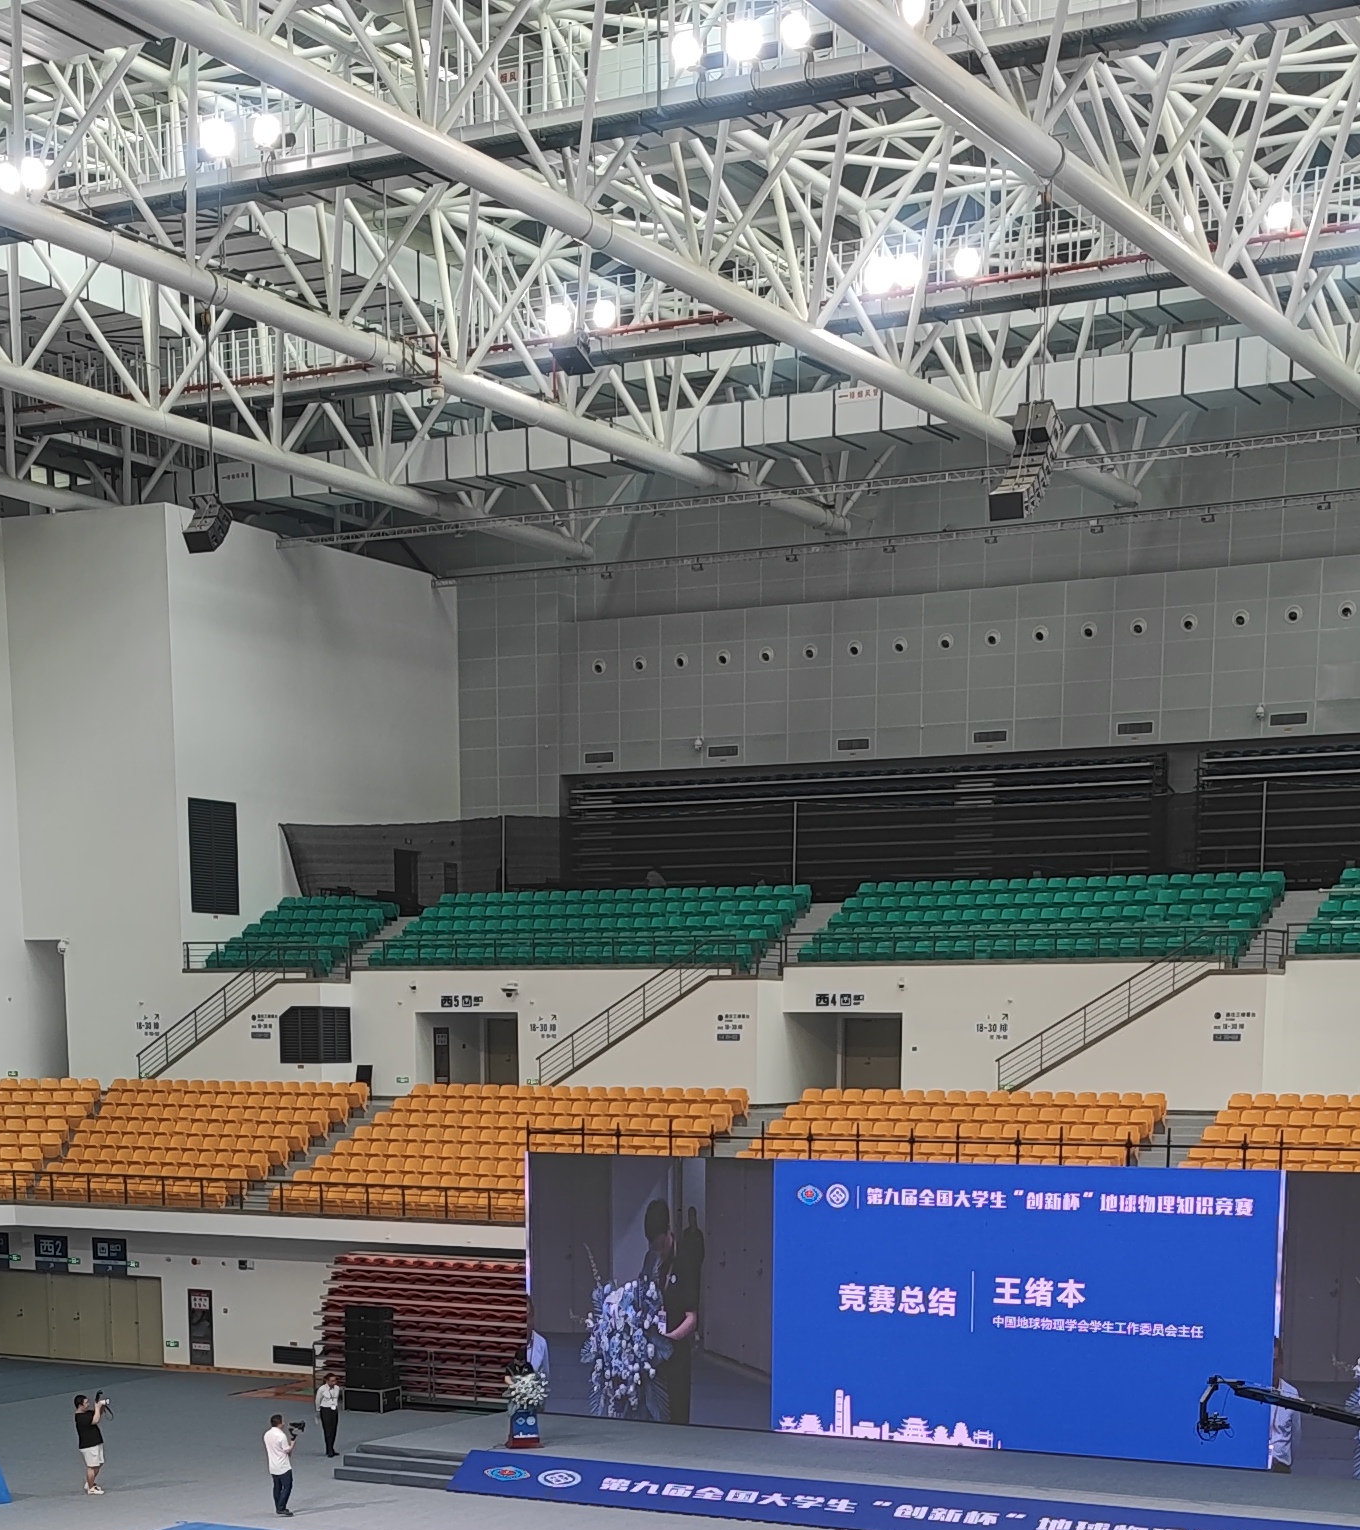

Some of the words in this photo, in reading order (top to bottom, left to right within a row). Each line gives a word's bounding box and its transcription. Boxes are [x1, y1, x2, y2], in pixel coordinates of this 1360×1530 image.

[440, 995, 460, 1008] 西5
[815, 994, 837, 1007] 西4
[40, 1239, 64, 1256] 西2
[838, 1283, 958, 1317] 竞赛总结
[993, 1276, 1087, 1309] 王绪本
[992, 1314, 1205, 1339] 中国地球物理学会学生工作委员会主任
